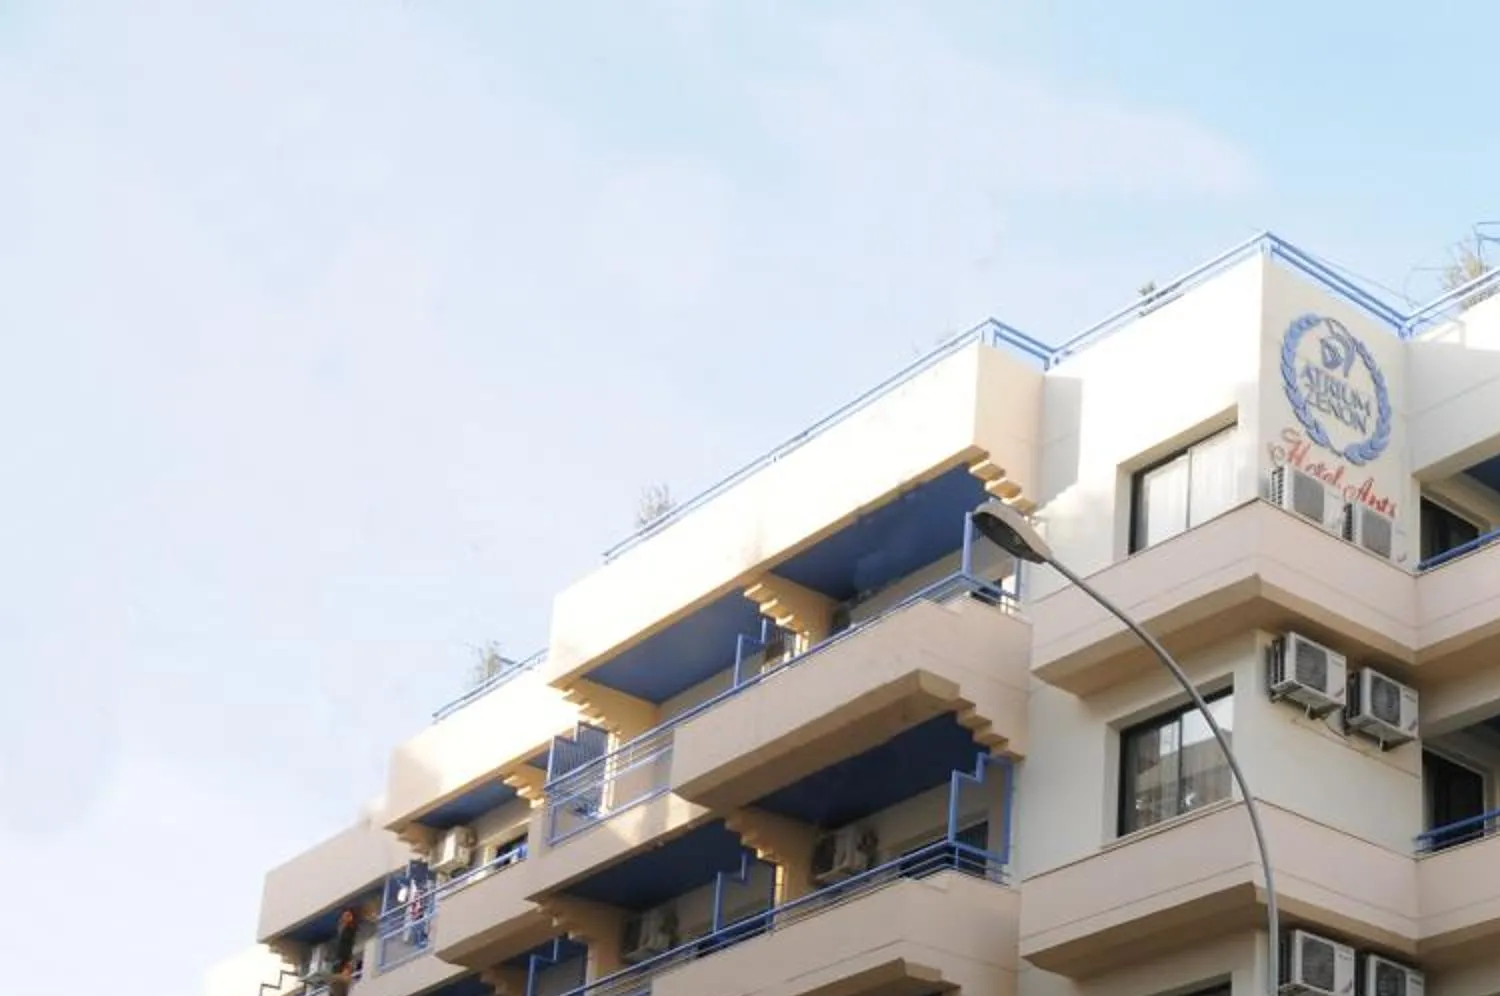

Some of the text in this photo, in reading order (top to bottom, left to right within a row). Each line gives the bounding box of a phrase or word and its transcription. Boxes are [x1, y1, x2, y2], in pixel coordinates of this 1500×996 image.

[1301, 365, 1371, 416] ATRIUM
[1305, 383, 1368, 434] ZENON
[1267, 427, 1344, 485] Hotel
